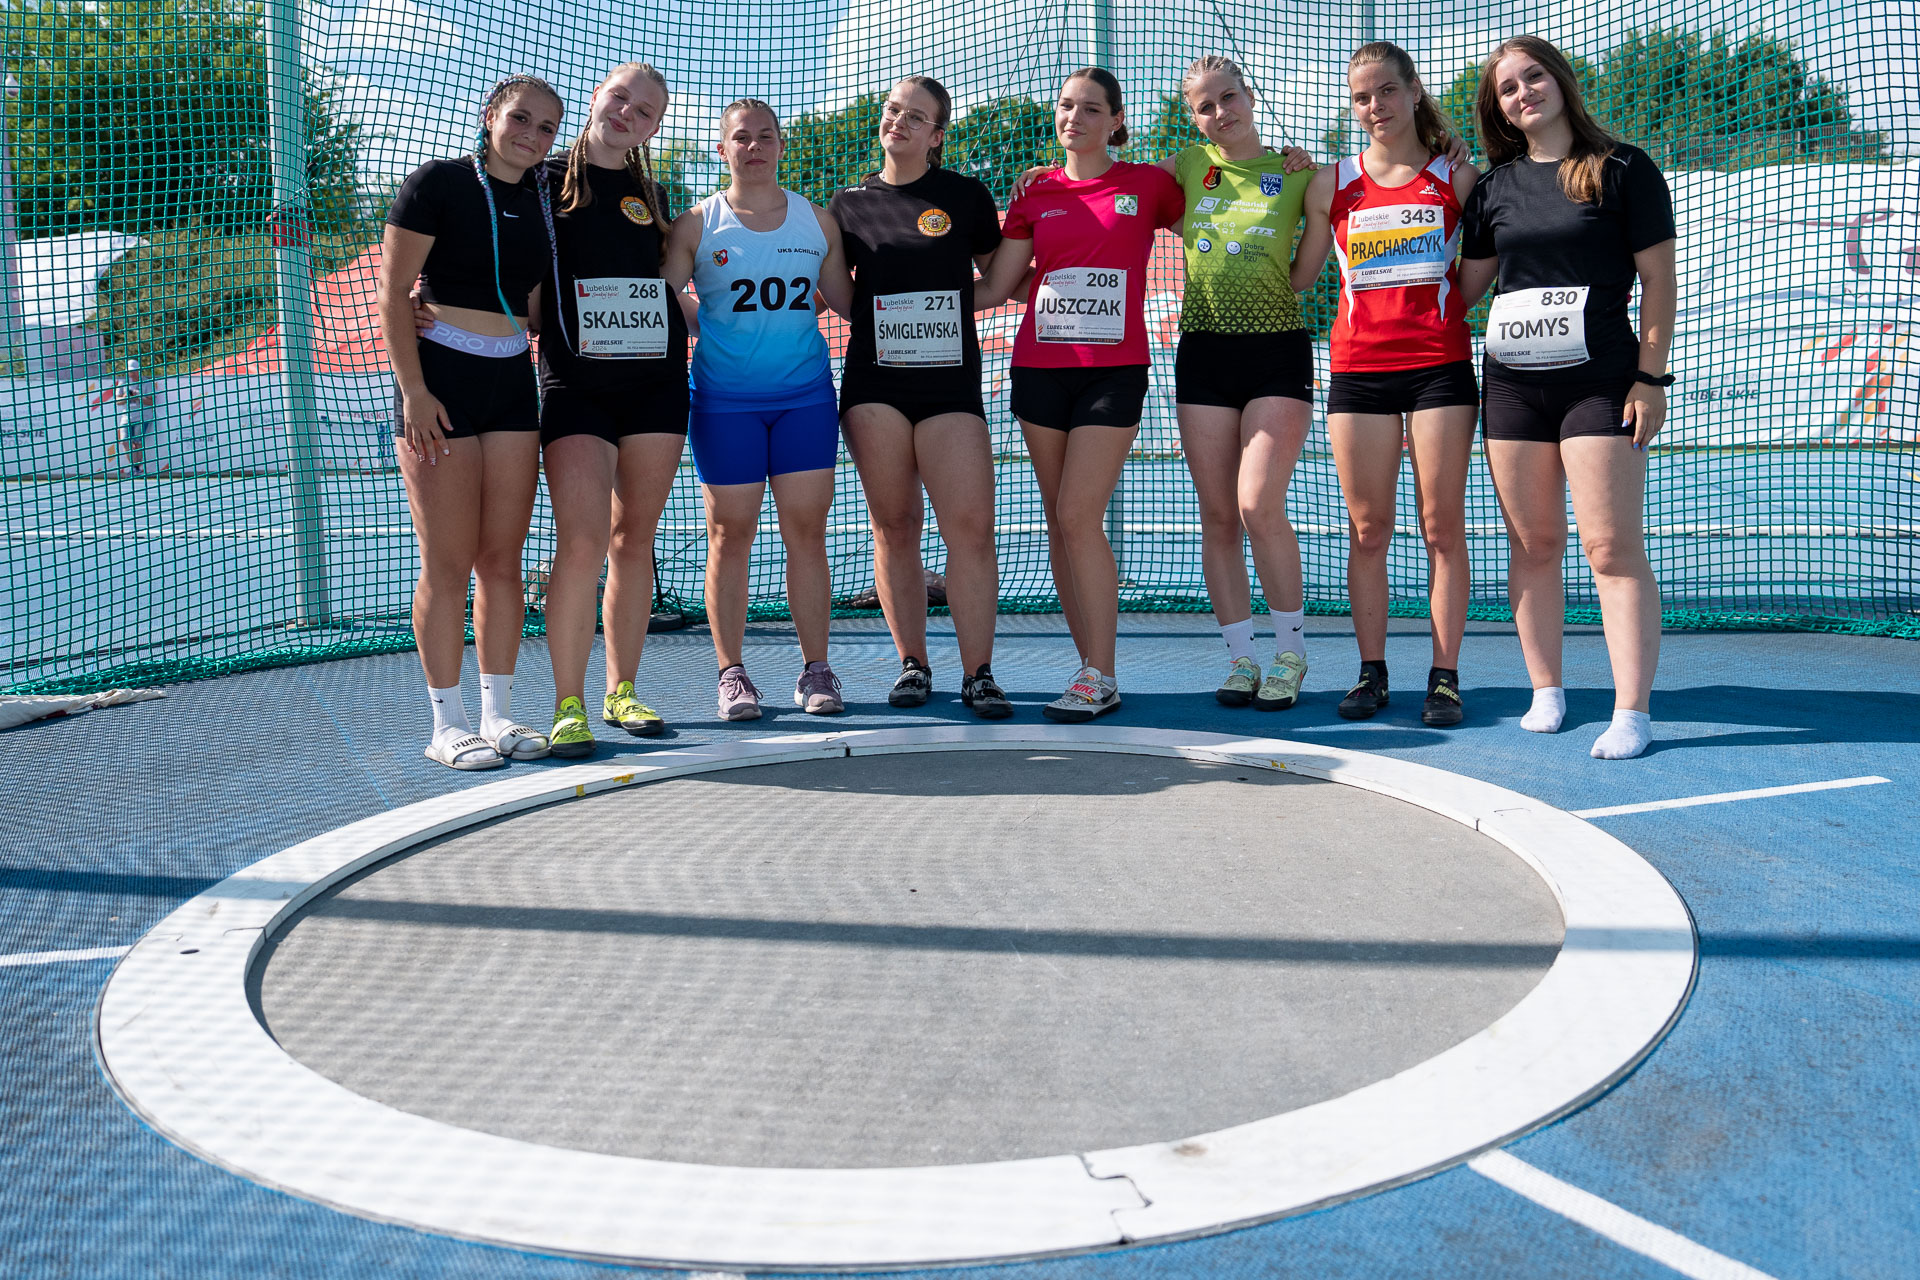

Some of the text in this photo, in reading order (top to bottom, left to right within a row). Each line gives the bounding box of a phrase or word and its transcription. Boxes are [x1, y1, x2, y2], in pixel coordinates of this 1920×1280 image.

[1400, 209, 1436, 225] 343
[1192, 222, 1220, 230] MZK
[794, 248, 820, 256] ACHILLES
[1244, 243, 1265, 251] Dobra
[1351, 235, 1442, 260] PRACHARCZYK
[1243, 255, 1258, 263] PZU
[1361, 268, 1393, 276] LUBELSKIE
[1086, 273, 1119, 288] 208
[628, 283, 659, 299] 268
[730, 276, 811, 312] 202
[1541, 290, 1578, 306] 830
[924, 296, 955, 311] 271
[1039, 298, 1121, 317] JUSZCZAK
[583, 311, 665, 329] SKALSKA
[878, 320, 959, 340] ŚMIGLEWSKA
[1498, 317, 1570, 340] TOMYS
[431, 326, 527, 353] PRO NIKE
[1070, 683, 1098, 696] NIKE
[1434, 685, 1460, 702] NIKE
